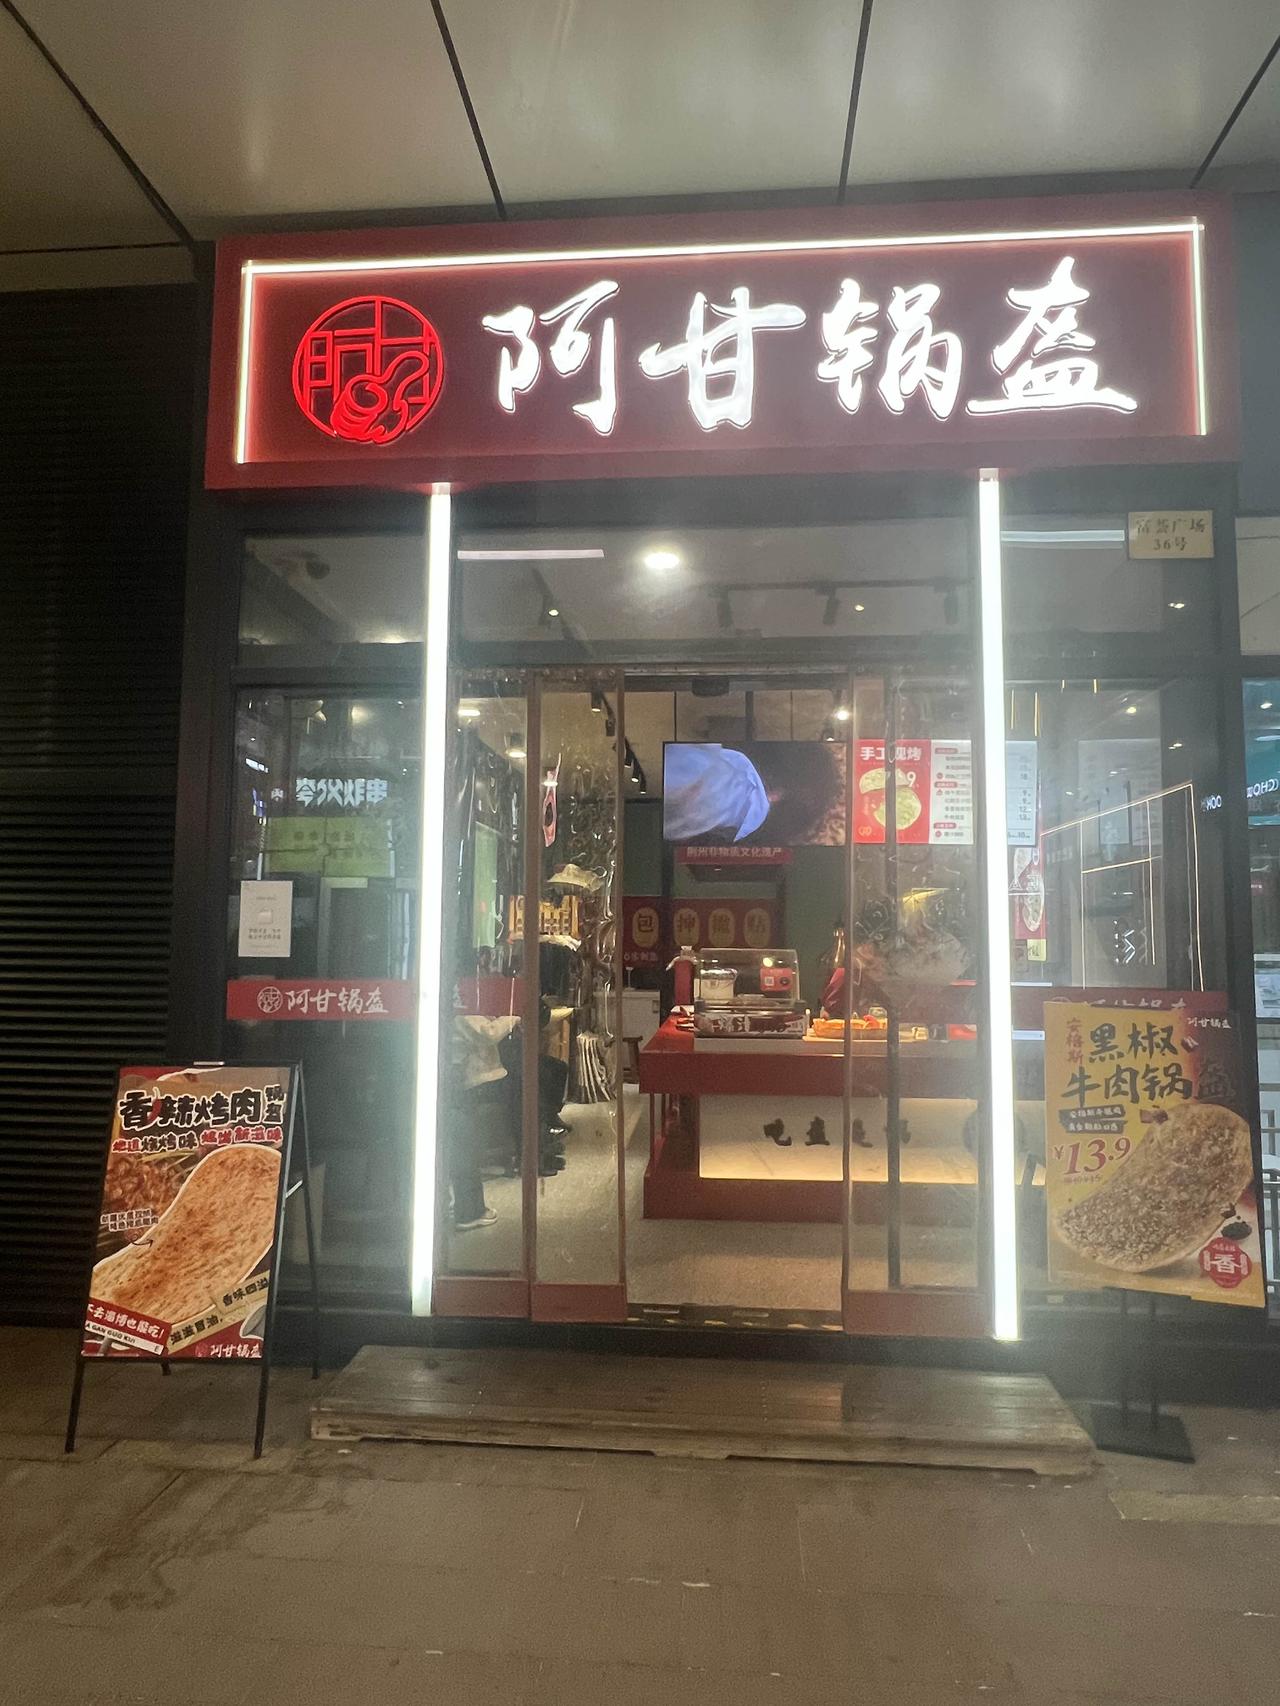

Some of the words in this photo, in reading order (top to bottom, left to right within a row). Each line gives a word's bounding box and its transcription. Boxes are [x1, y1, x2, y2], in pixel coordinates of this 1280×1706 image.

[482, 256, 1138, 436] 阿甘锅盔
[285, 986, 389, 1014] 阿甘锅盔
[1089, 1021, 1178, 1064] 黑椒
